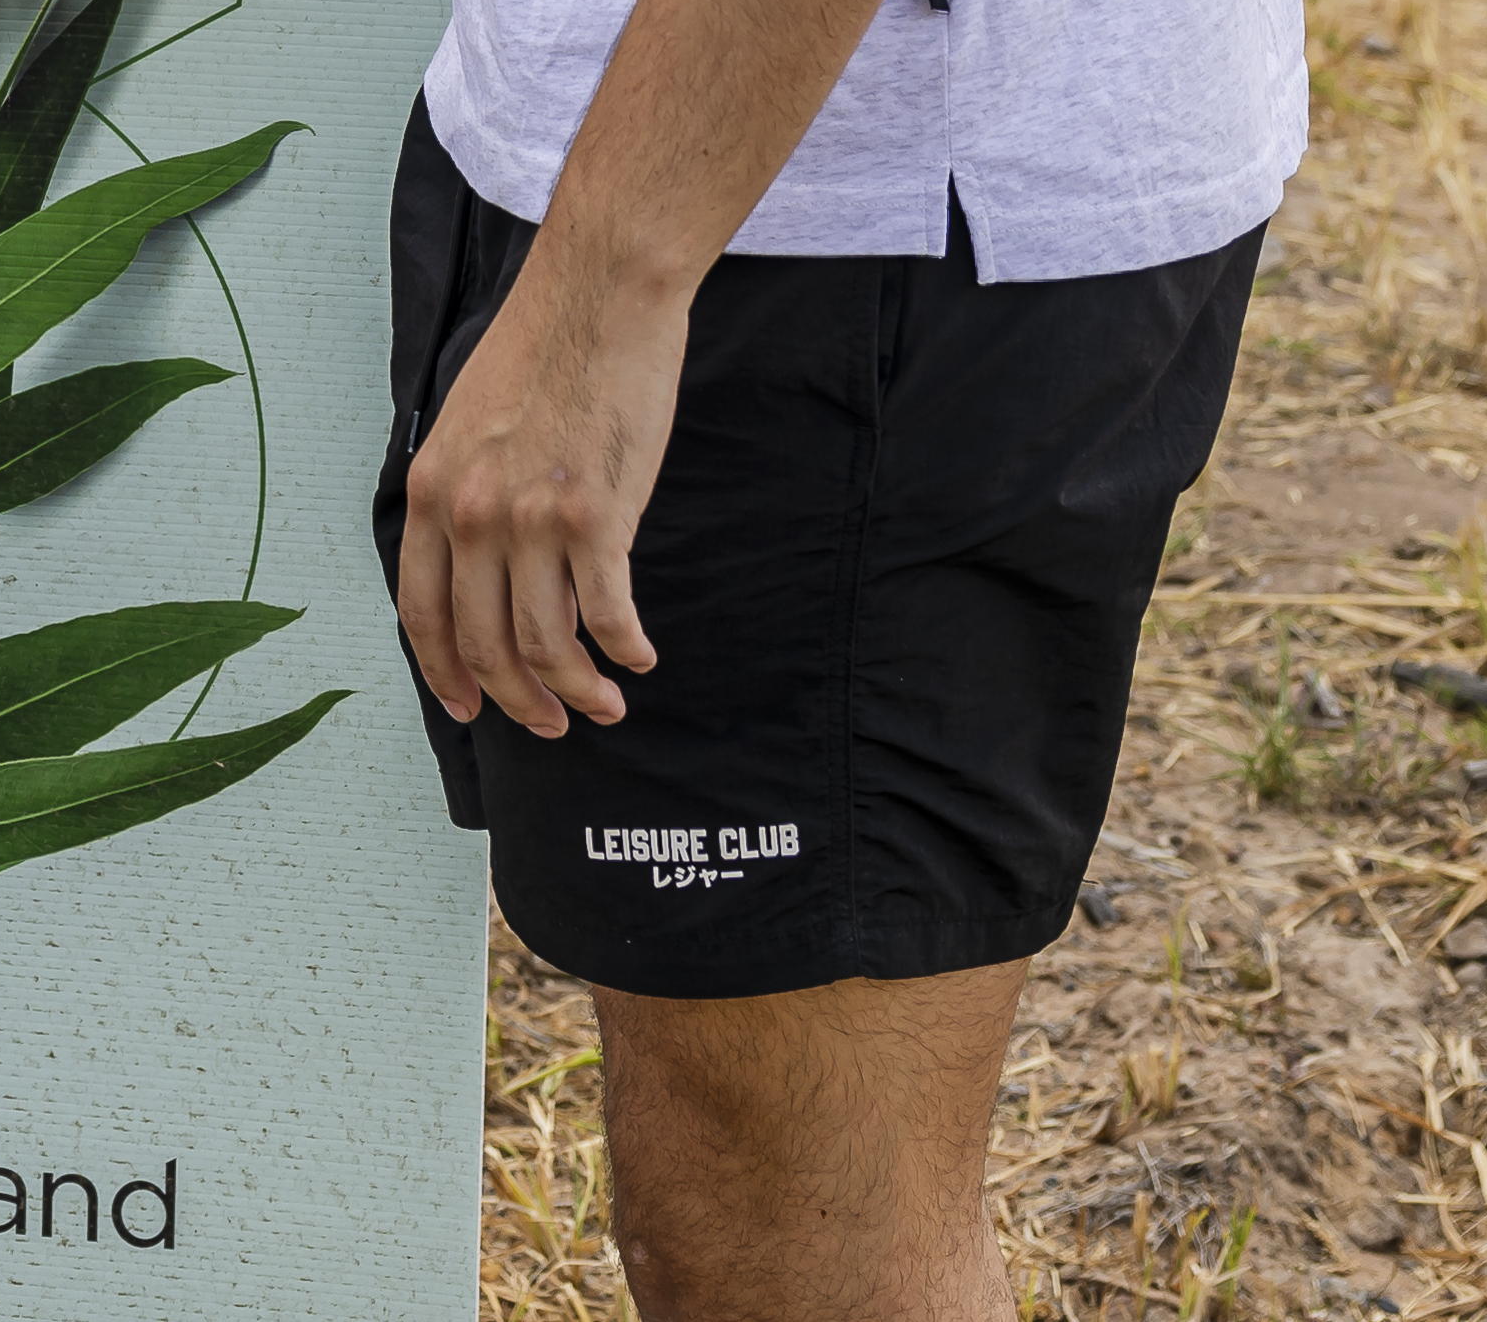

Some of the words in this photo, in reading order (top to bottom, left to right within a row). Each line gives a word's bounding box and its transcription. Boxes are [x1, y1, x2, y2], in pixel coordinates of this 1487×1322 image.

[585, 826, 709, 863] LEISURE
[718, 823, 800, 860] CLUB
[652, 865, 744, 889] レジャー
